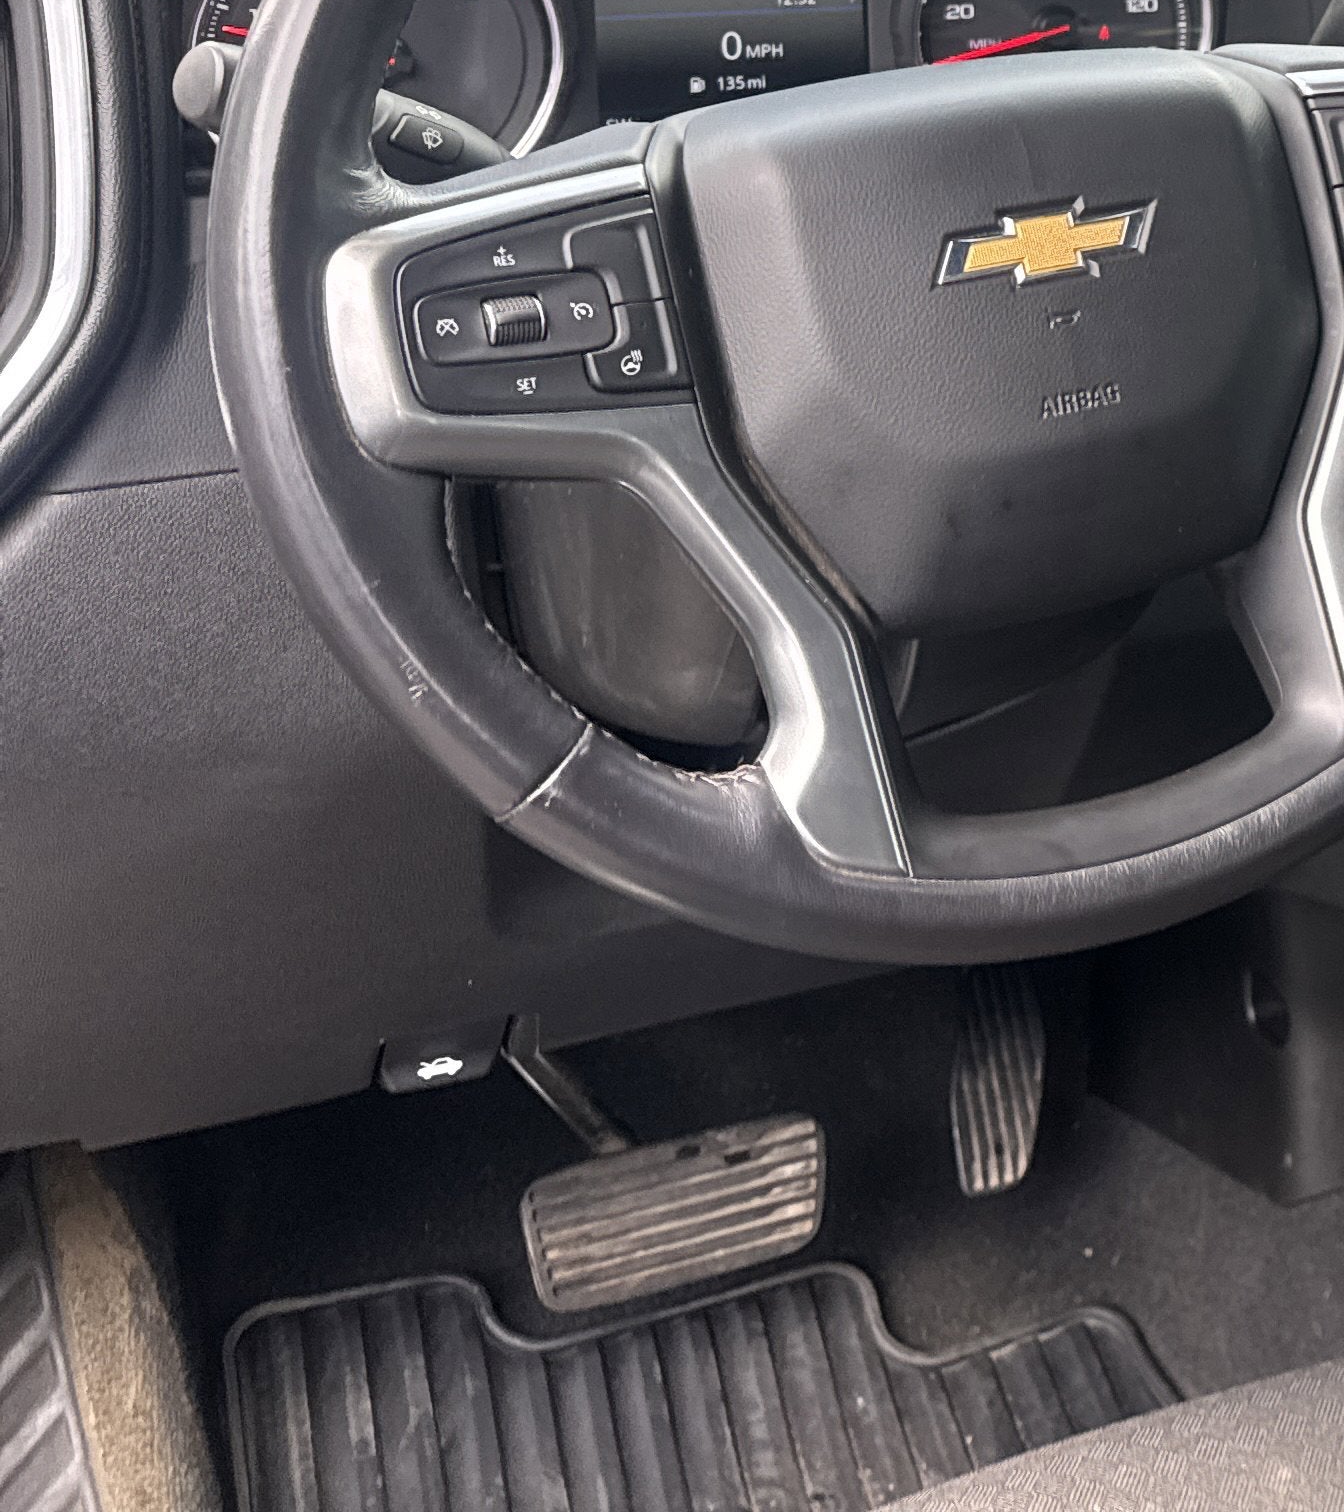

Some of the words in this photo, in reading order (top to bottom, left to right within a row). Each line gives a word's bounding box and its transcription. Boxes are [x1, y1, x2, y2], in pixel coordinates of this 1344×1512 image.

[945, 4, 974, 20] 20
[721, 31, 743, 61] 0
[745, 43, 784, 59] MPH
[718, 76, 745, 91] 135
[747, 75, 766, 89] mi
[493, 254, 515, 267] RES
[516, 377, 536, 391] SET
[1041, 383, 1120, 420] AIRBAG
